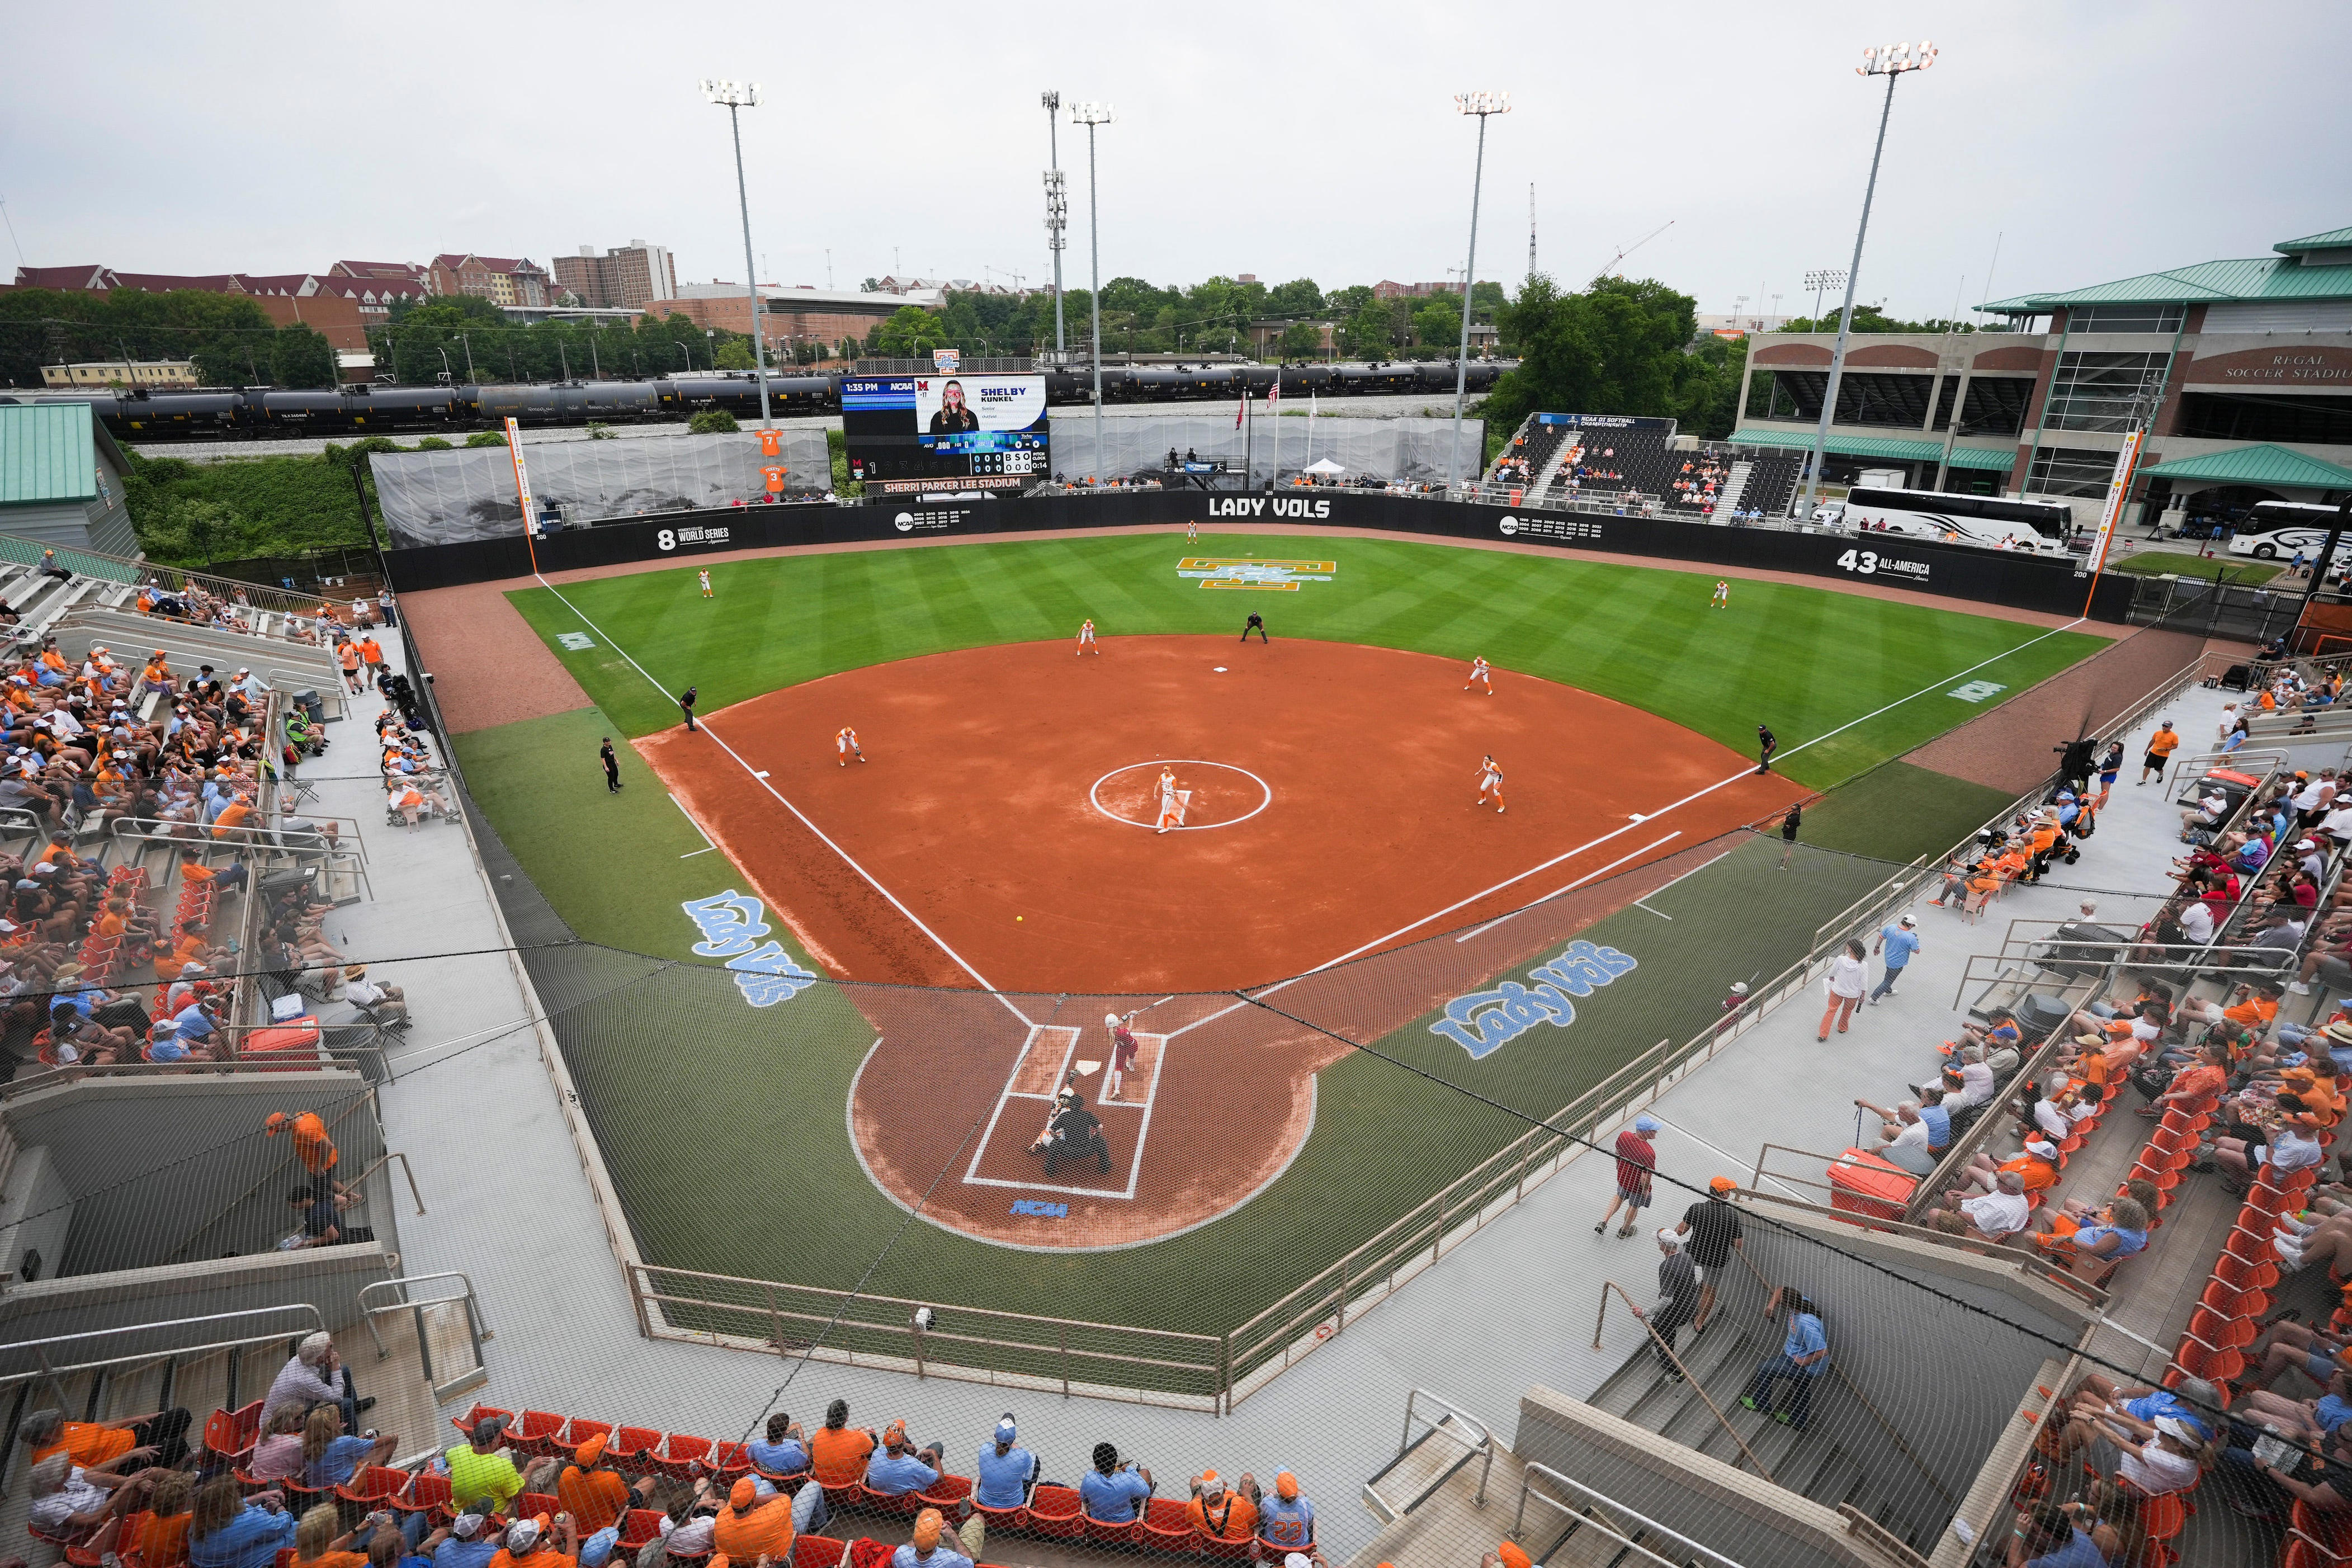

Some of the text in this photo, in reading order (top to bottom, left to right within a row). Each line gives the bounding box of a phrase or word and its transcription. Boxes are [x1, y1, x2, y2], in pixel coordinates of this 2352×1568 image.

[2273, 356, 2325, 364] REGAL
[2225, 369, 2283, 377] SOCCER
[846, 383, 863, 391] 1:35
[981, 388, 1026, 396] SHELBY
[511, 426, 521, 456] Hiller
[870, 461, 876, 474] 1
[2118, 442, 2133, 479] Hiller
[518, 465, 527, 494] Hiller
[771, 473, 777, 481] 3
[884, 478, 1021, 493] SHERRI PARKER LEE STADIUM
[1209, 498, 1330, 518] LADY VOLS
[2105, 488, 2119, 523] Hiller
[525, 502, 535, 532] Hiller
[658, 530, 676, 550] 8
[678, 527, 729, 542] WORLD SERIES
[2091, 532, 2106, 566] Hiller
[1837, 549, 1878, 574] 43
[1879, 558, 1929, 575] ALL-AMERICA
[555, 631, 597, 651] NCAA
[1946, 680, 2008, 703] NCAA
[681, 889, 818, 1007] Lady Vols
[1428, 939, 1638, 1061] Lady Vols
[1009, 1199, 1069, 1218] NCAA
[1274, 1520, 1302, 1542] 23
